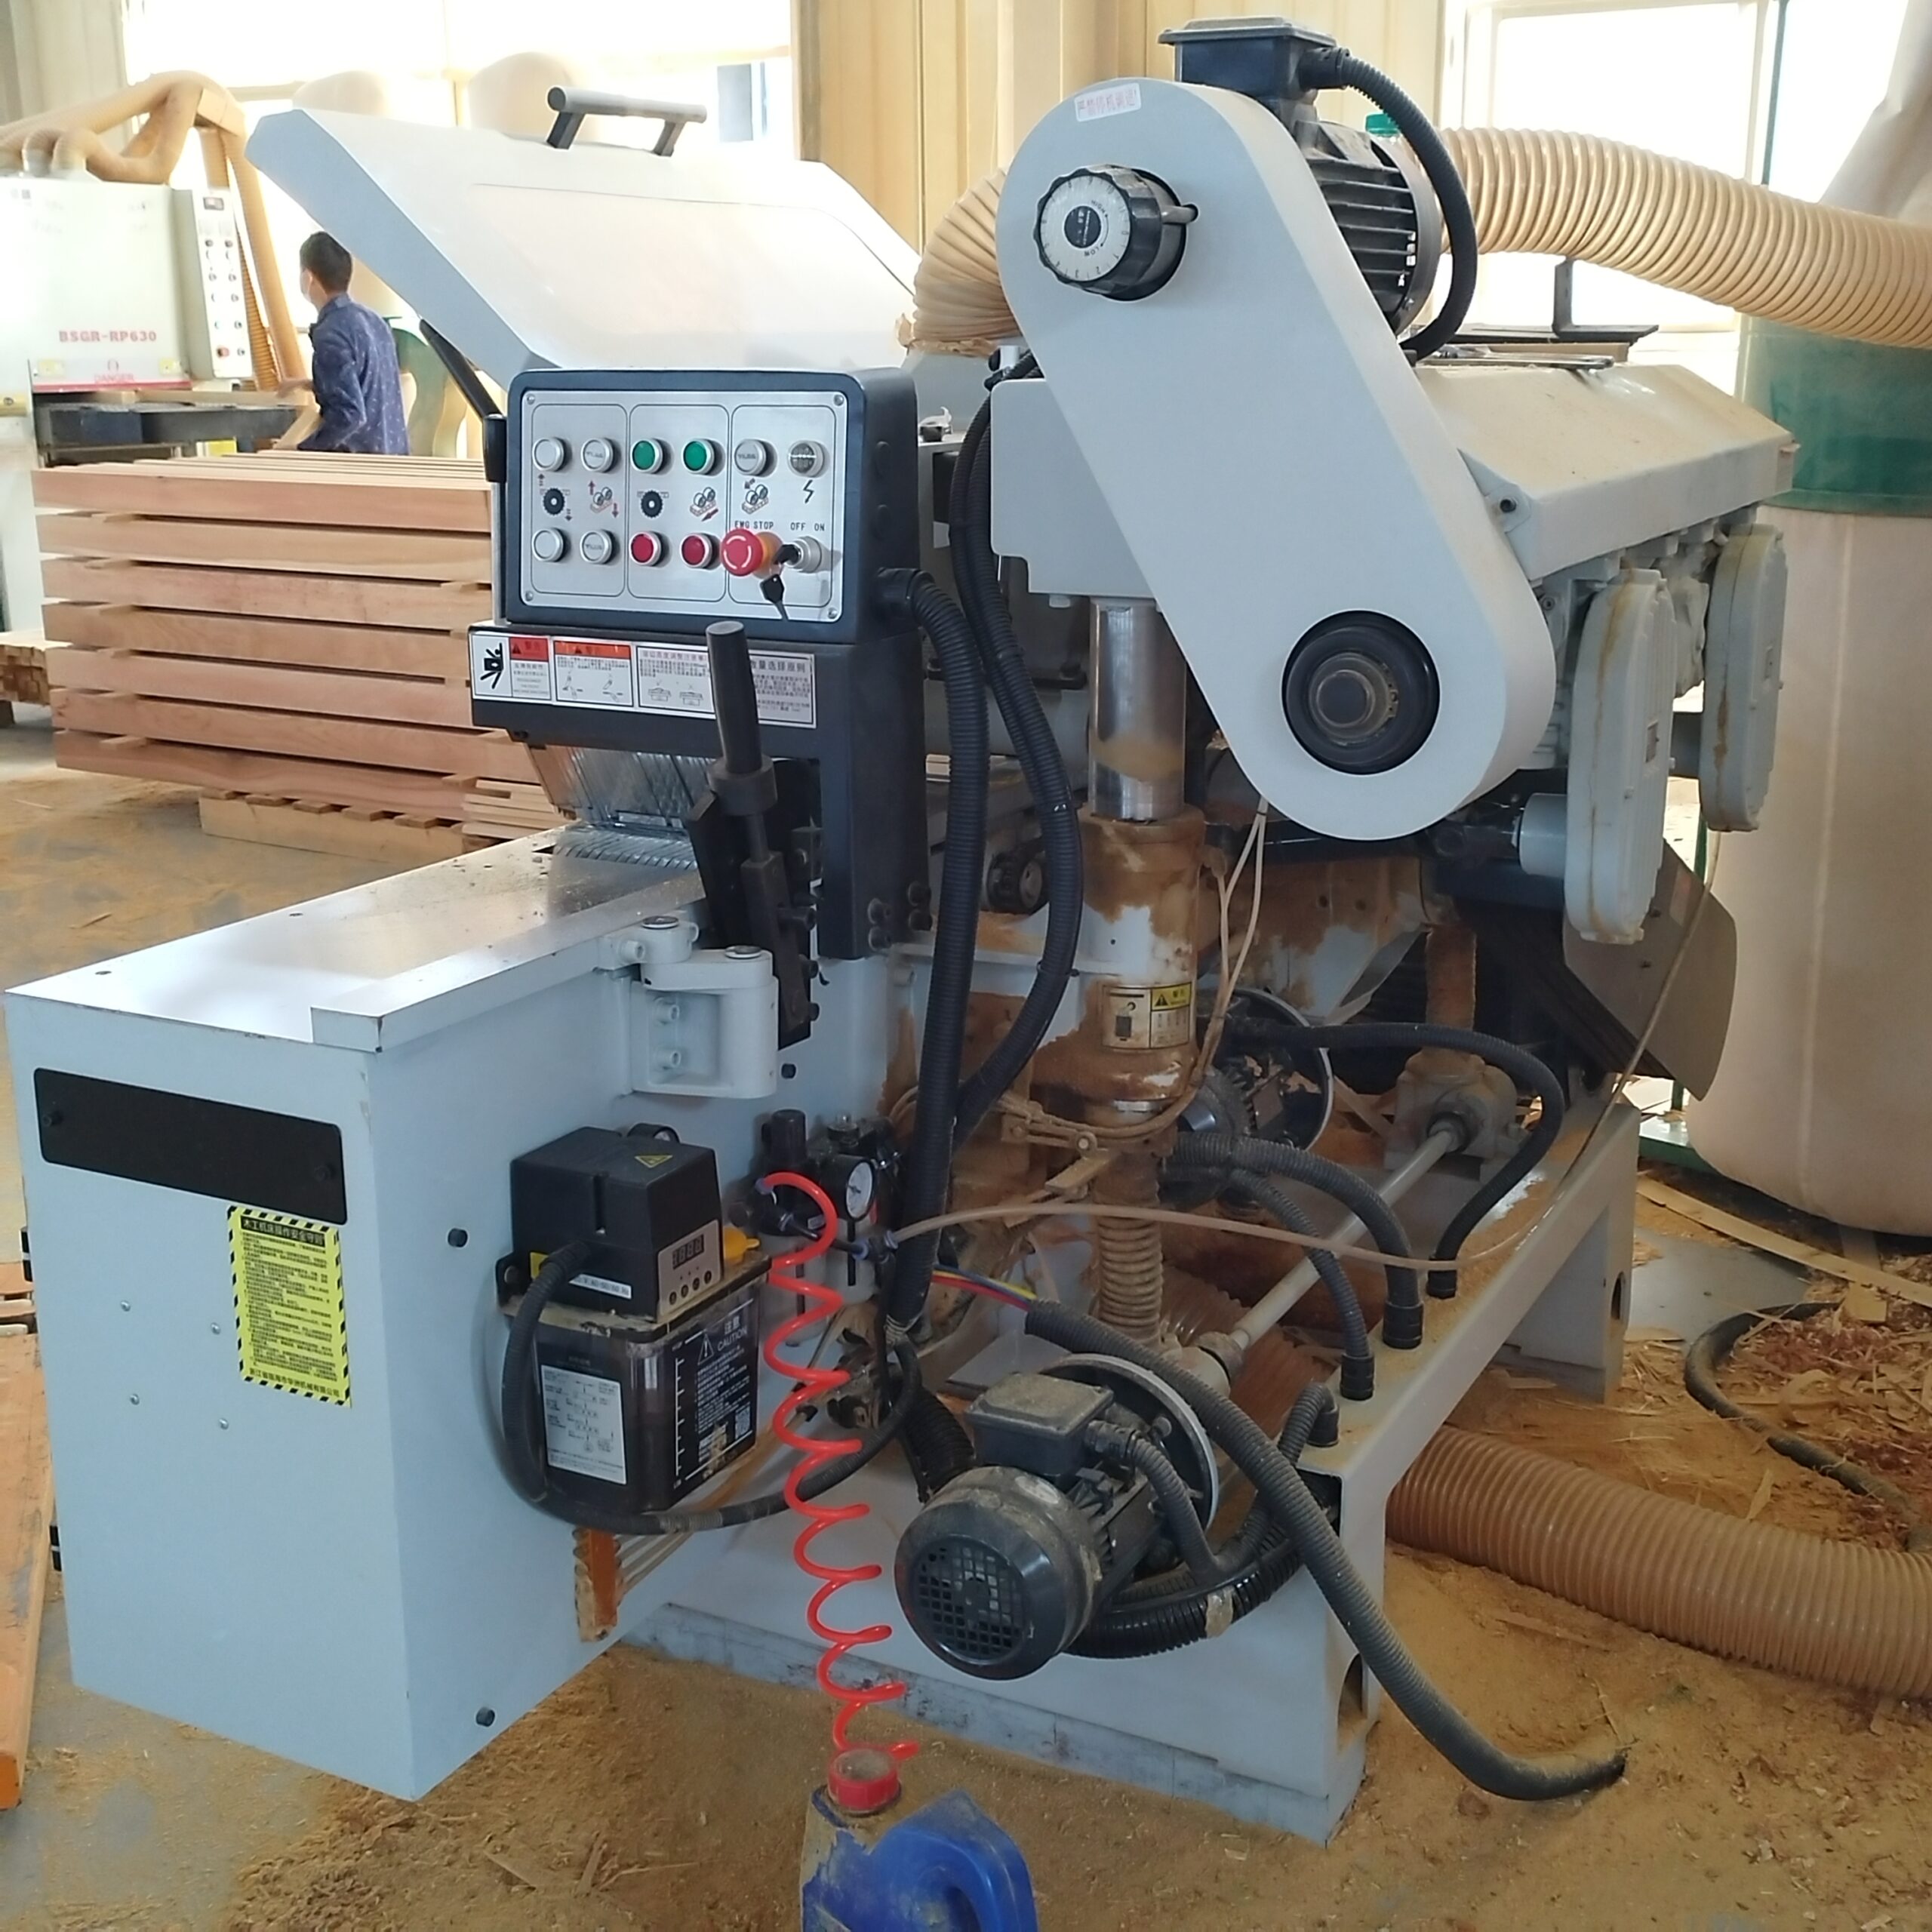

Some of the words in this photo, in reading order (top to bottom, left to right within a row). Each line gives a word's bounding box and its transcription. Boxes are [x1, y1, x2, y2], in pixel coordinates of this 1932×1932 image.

[59, 331, 157, 343] BSGR-RP630
[753, 521, 774, 530] STOP
[790, 521, 806, 531] OFF
[814, 522, 826, 531] ON
[718, 1326, 748, 1352] CAUTION
